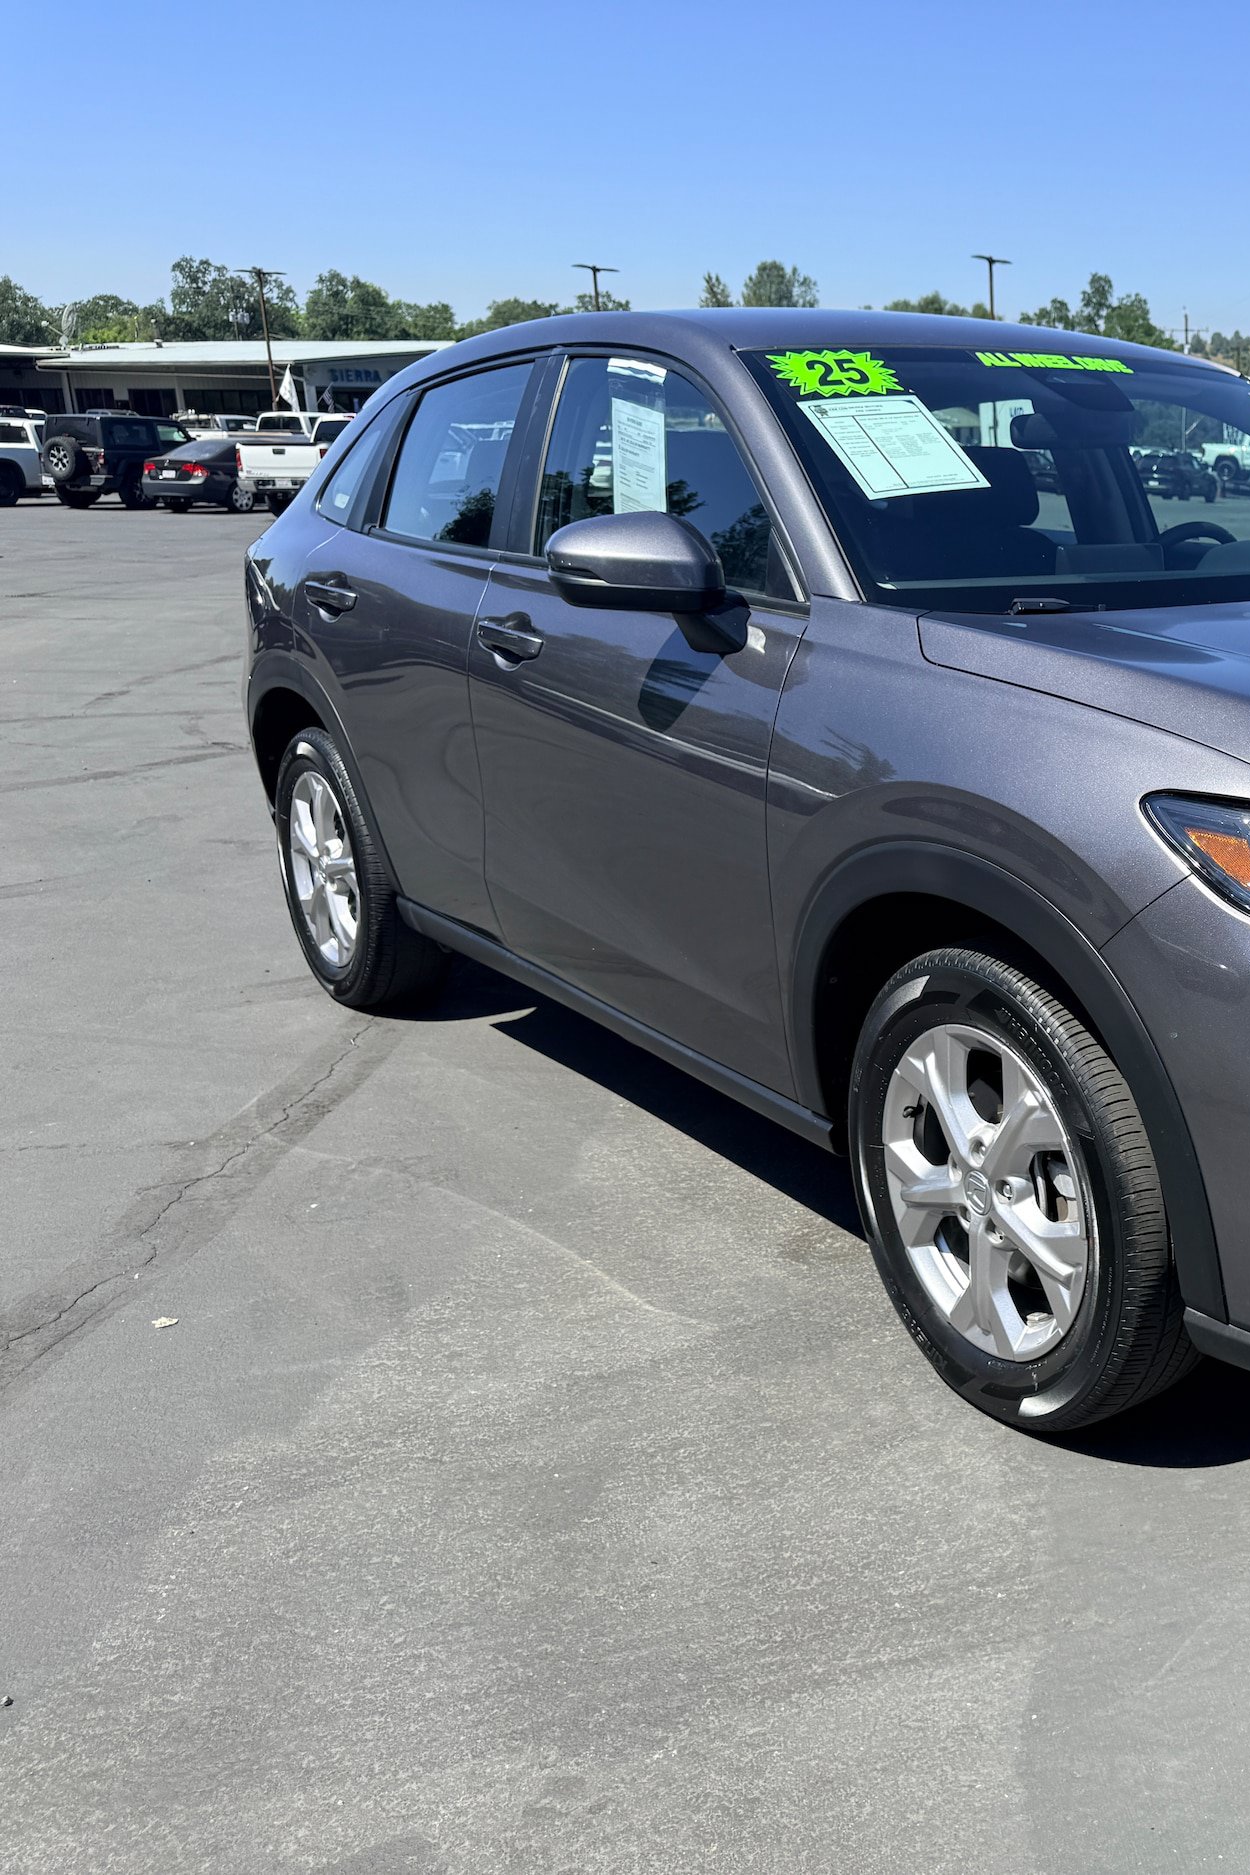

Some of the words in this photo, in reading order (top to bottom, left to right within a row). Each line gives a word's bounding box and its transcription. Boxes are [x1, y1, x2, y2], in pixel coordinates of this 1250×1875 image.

[805, 359, 870, 386] 25
[975, 352, 1022, 367] ALL
[1008, 353, 1085, 370] WHEEL
[1071, 356, 1135, 374] DRIVE
[328, 368, 381, 382] SIERRA
